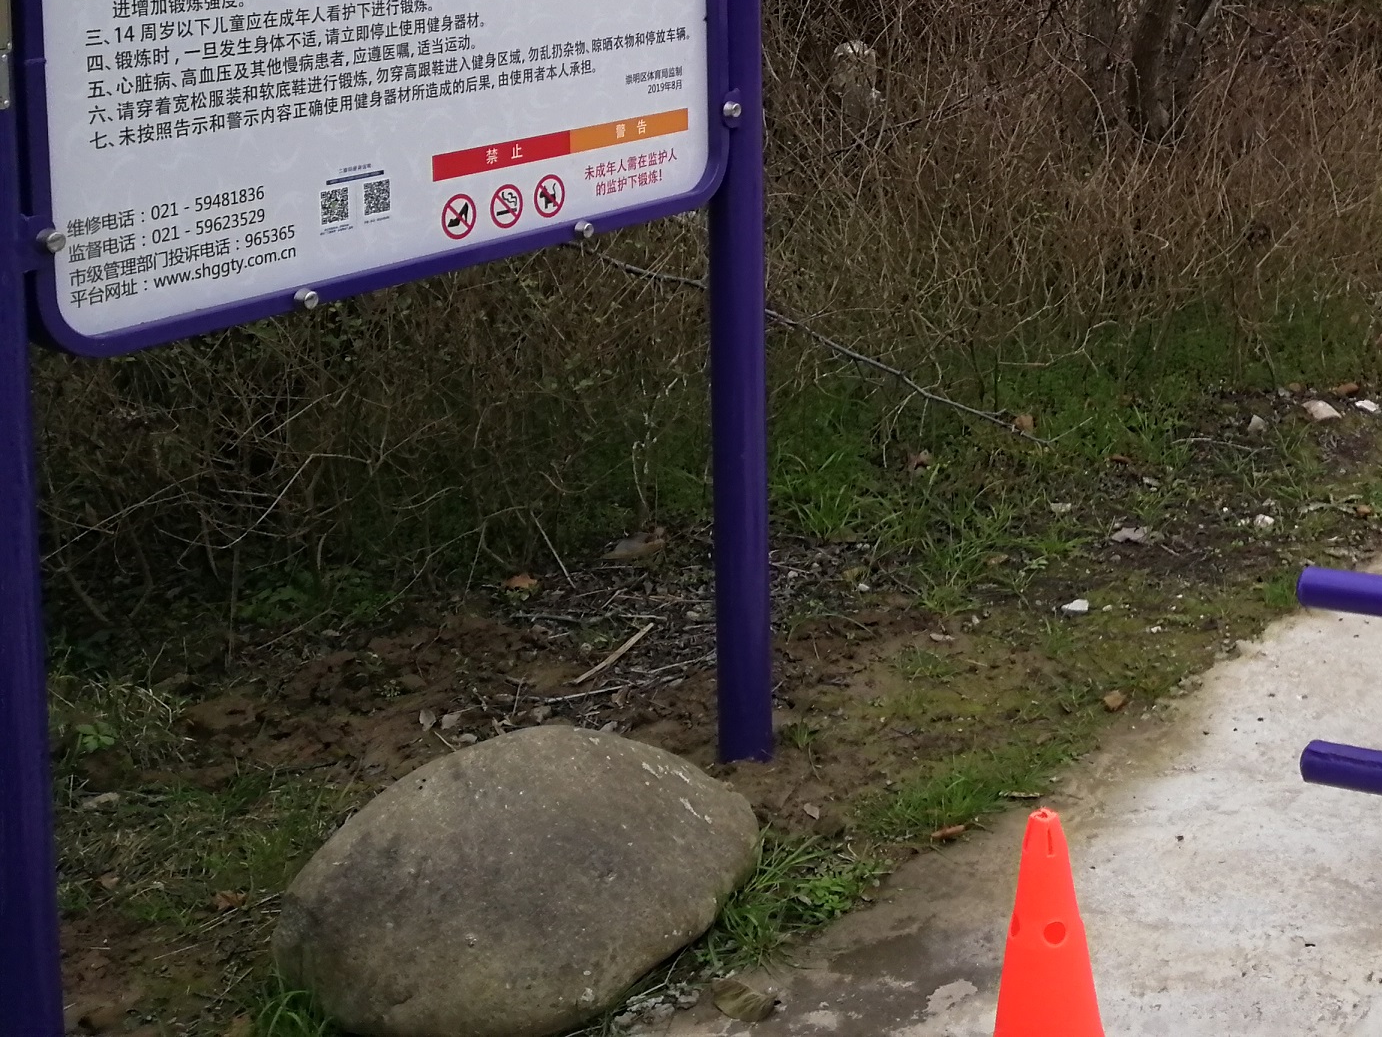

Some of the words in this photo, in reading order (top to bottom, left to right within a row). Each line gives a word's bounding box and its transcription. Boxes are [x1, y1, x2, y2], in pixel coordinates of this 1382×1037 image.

[648, 82, 683, 95] 2019年8月
[615, 120, 647, 139] 警告
[486, 144, 523, 164] 禁止
[585, 148, 677, 180] 未成年人需在监护人
